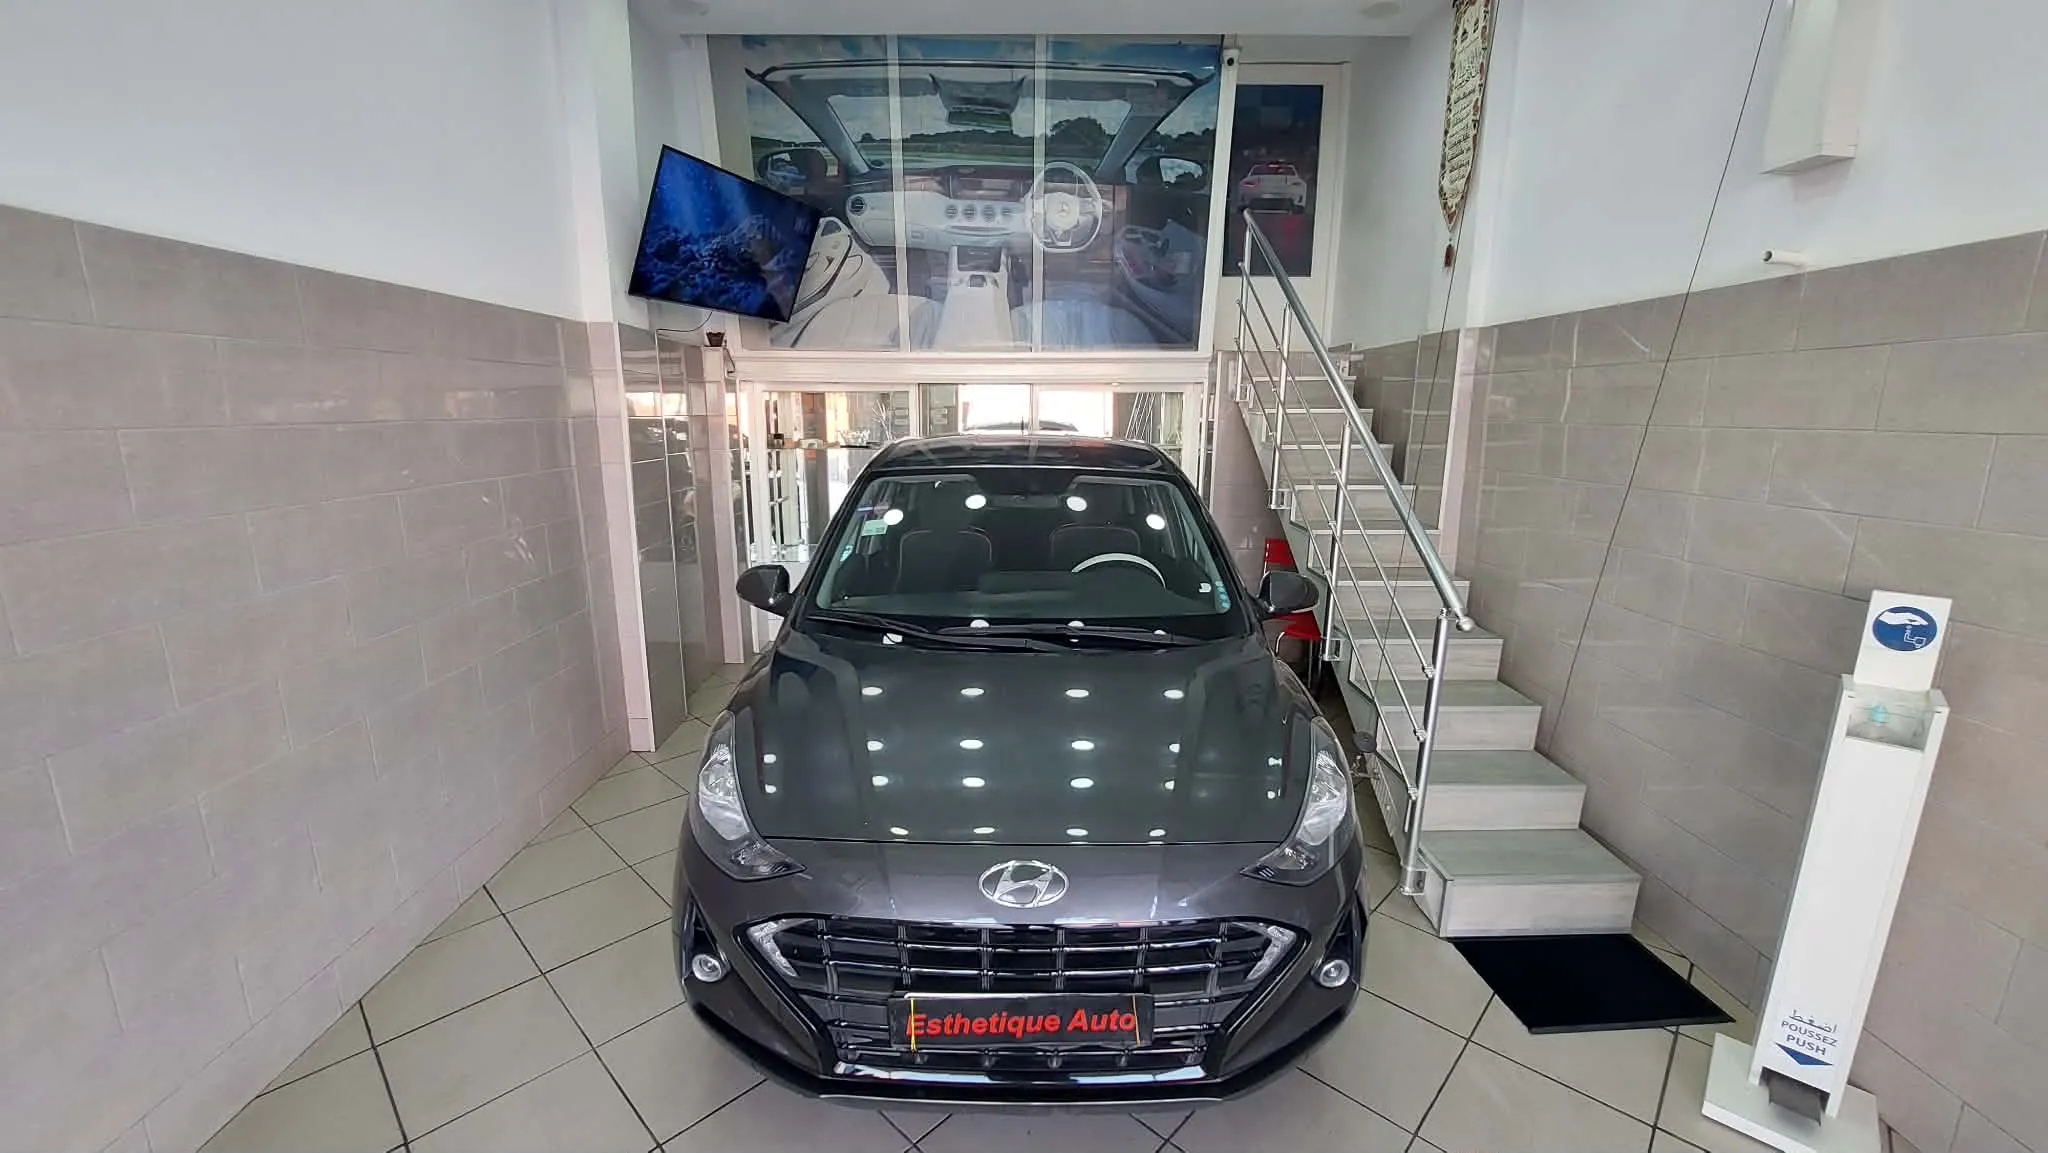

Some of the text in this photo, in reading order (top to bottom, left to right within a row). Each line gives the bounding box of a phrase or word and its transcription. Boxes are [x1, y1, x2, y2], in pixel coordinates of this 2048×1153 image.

[906, 1008, 1136, 1039] Esthetique Auto
[1781, 1020, 1838, 1047] POUSSEZ
[1786, 1034, 1827, 1055] PUSH
